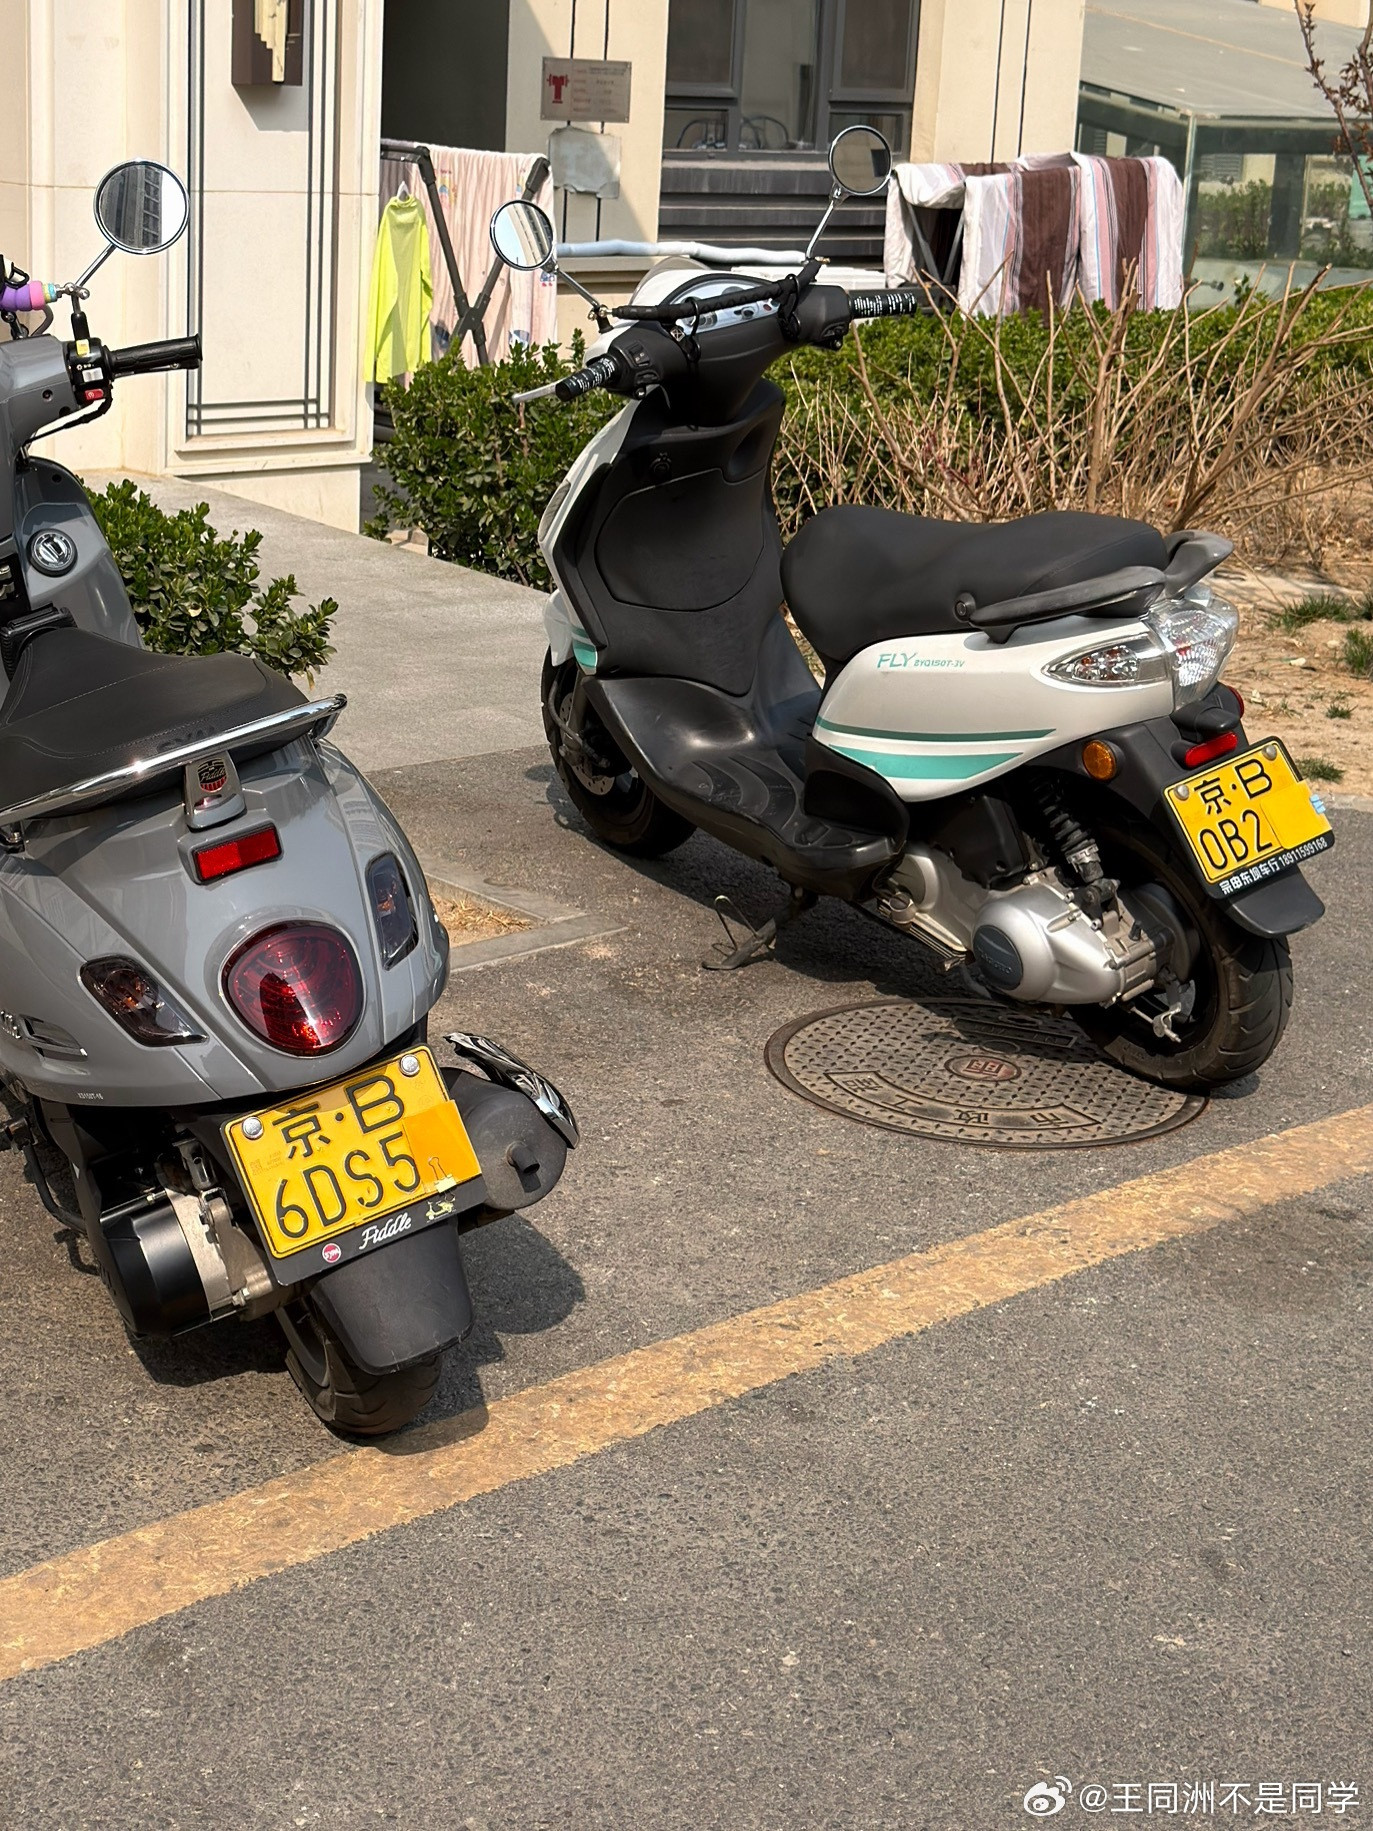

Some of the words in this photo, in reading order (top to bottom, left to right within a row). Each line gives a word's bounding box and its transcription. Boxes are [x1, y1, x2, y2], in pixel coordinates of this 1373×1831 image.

[877, 652, 918, 668] FLY
[1193, 758, 1273, 815] 京·B
[1279, 836, 1328, 867] 18911599168
[271, 1074, 406, 1160] 京·B
[275, 1130, 422, 1239] 6DS5
[359, 1212, 413, 1251] Fiddle
